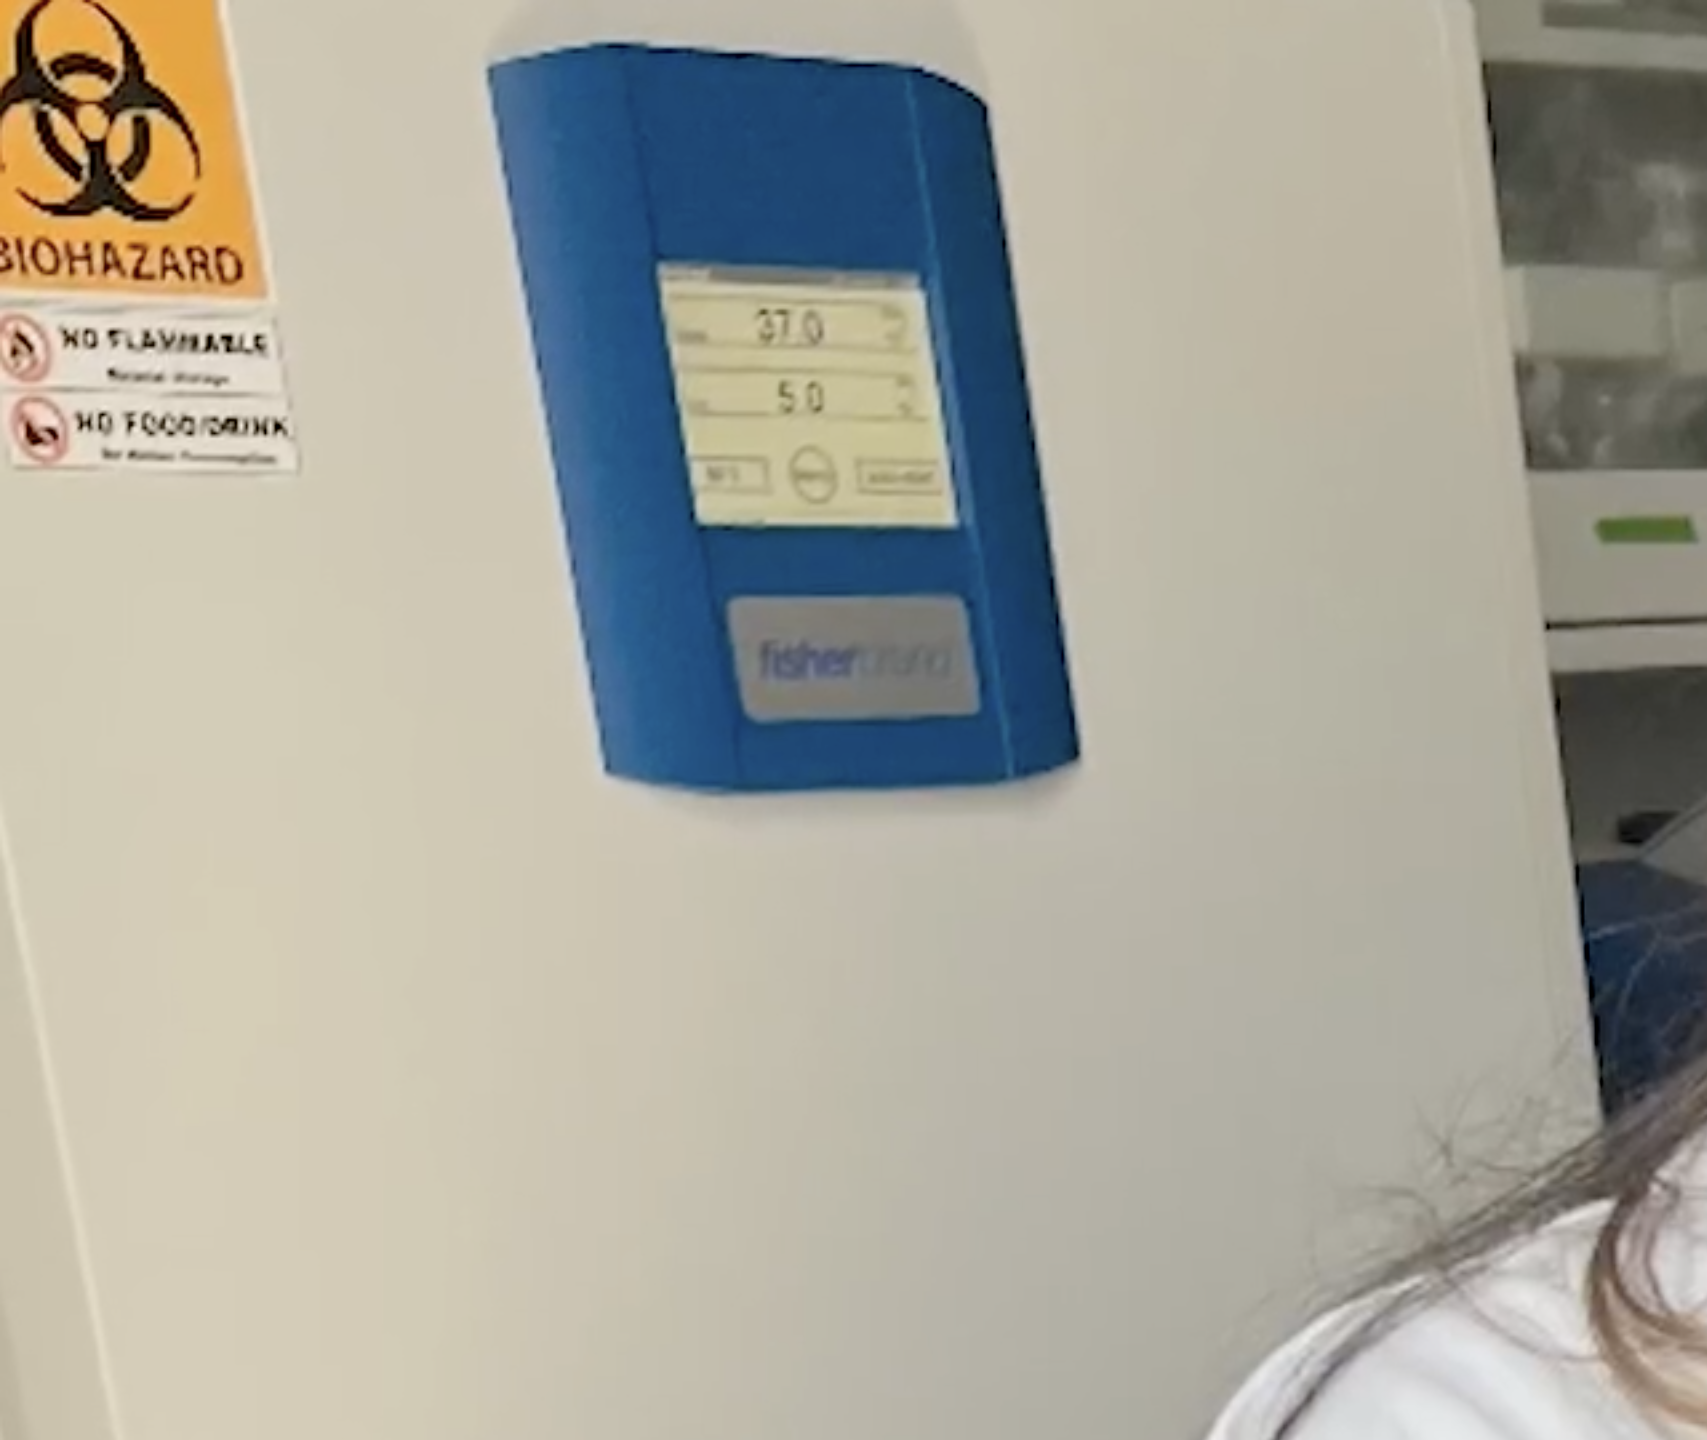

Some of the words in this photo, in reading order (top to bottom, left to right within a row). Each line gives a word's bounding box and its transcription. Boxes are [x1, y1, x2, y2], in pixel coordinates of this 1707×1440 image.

[61, 326, 99, 350] NO
[107, 328, 269, 358] FLAMMABLE
[76, 410, 114, 436] NO
[124, 411, 292, 438] FOOD/DRINK
